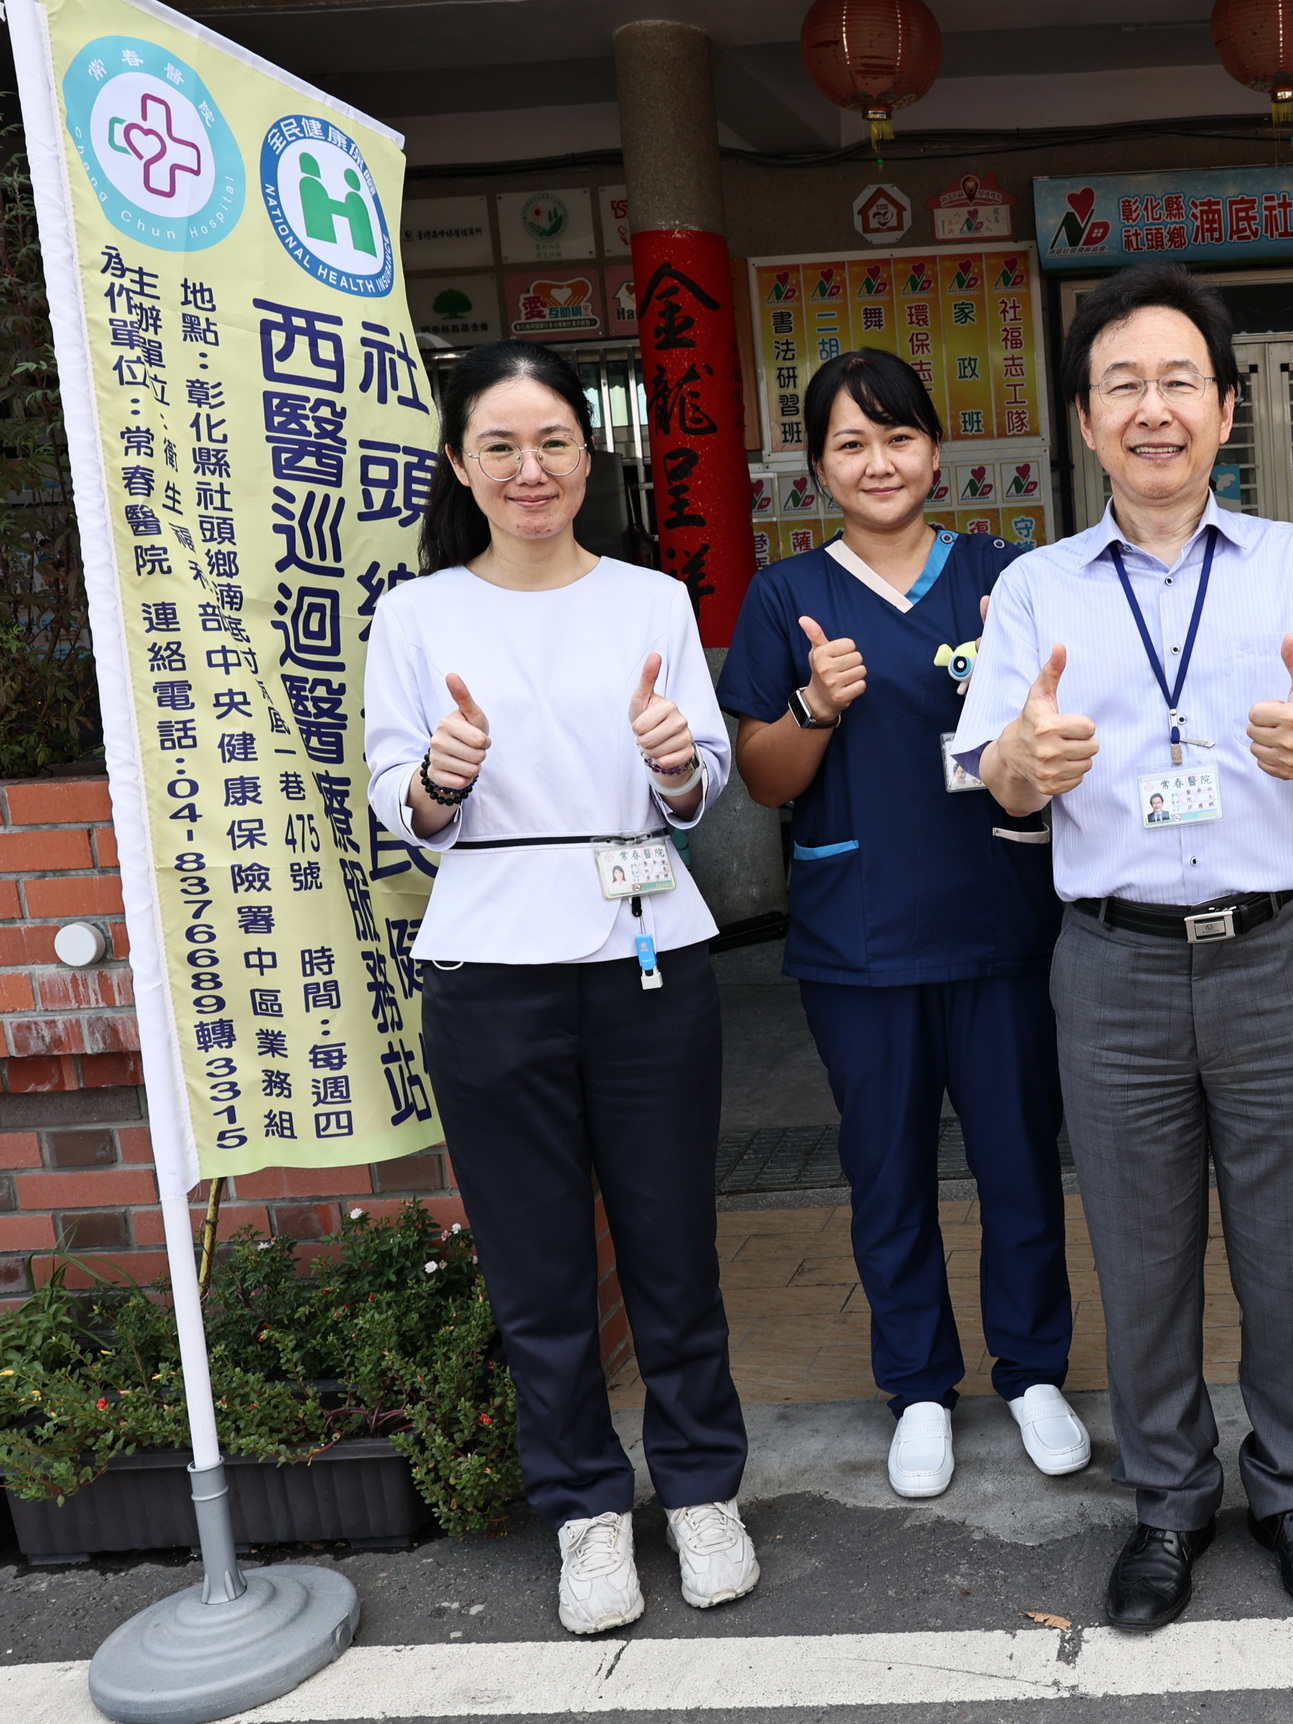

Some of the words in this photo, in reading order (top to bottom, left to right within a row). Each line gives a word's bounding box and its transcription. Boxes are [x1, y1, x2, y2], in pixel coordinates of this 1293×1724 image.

[87, 48, 216, 128] 常春醫院
[75, 126, 108, 203] Chang
[121, 210, 176, 239] Chun
[190, 176, 235, 239] Hospital
[267, 118, 377, 197] 全民健康保險
[265, 183, 310, 268] NATIONAL
[318, 265, 376, 293] HEALTH
[1120, 194, 1185, 223] 彰化縣
[1122, 225, 1187, 251] 社頭鄉
[862, 306, 885, 331] 舞
[771, 311, 802, 443] 書法研習班
[953, 301, 984, 434] 家政班
[998, 298, 1029, 434] 社福志工隊
[1160, 774, 1212, 790] 常春醫院
[619, 848, 665, 861] 常春醫院
